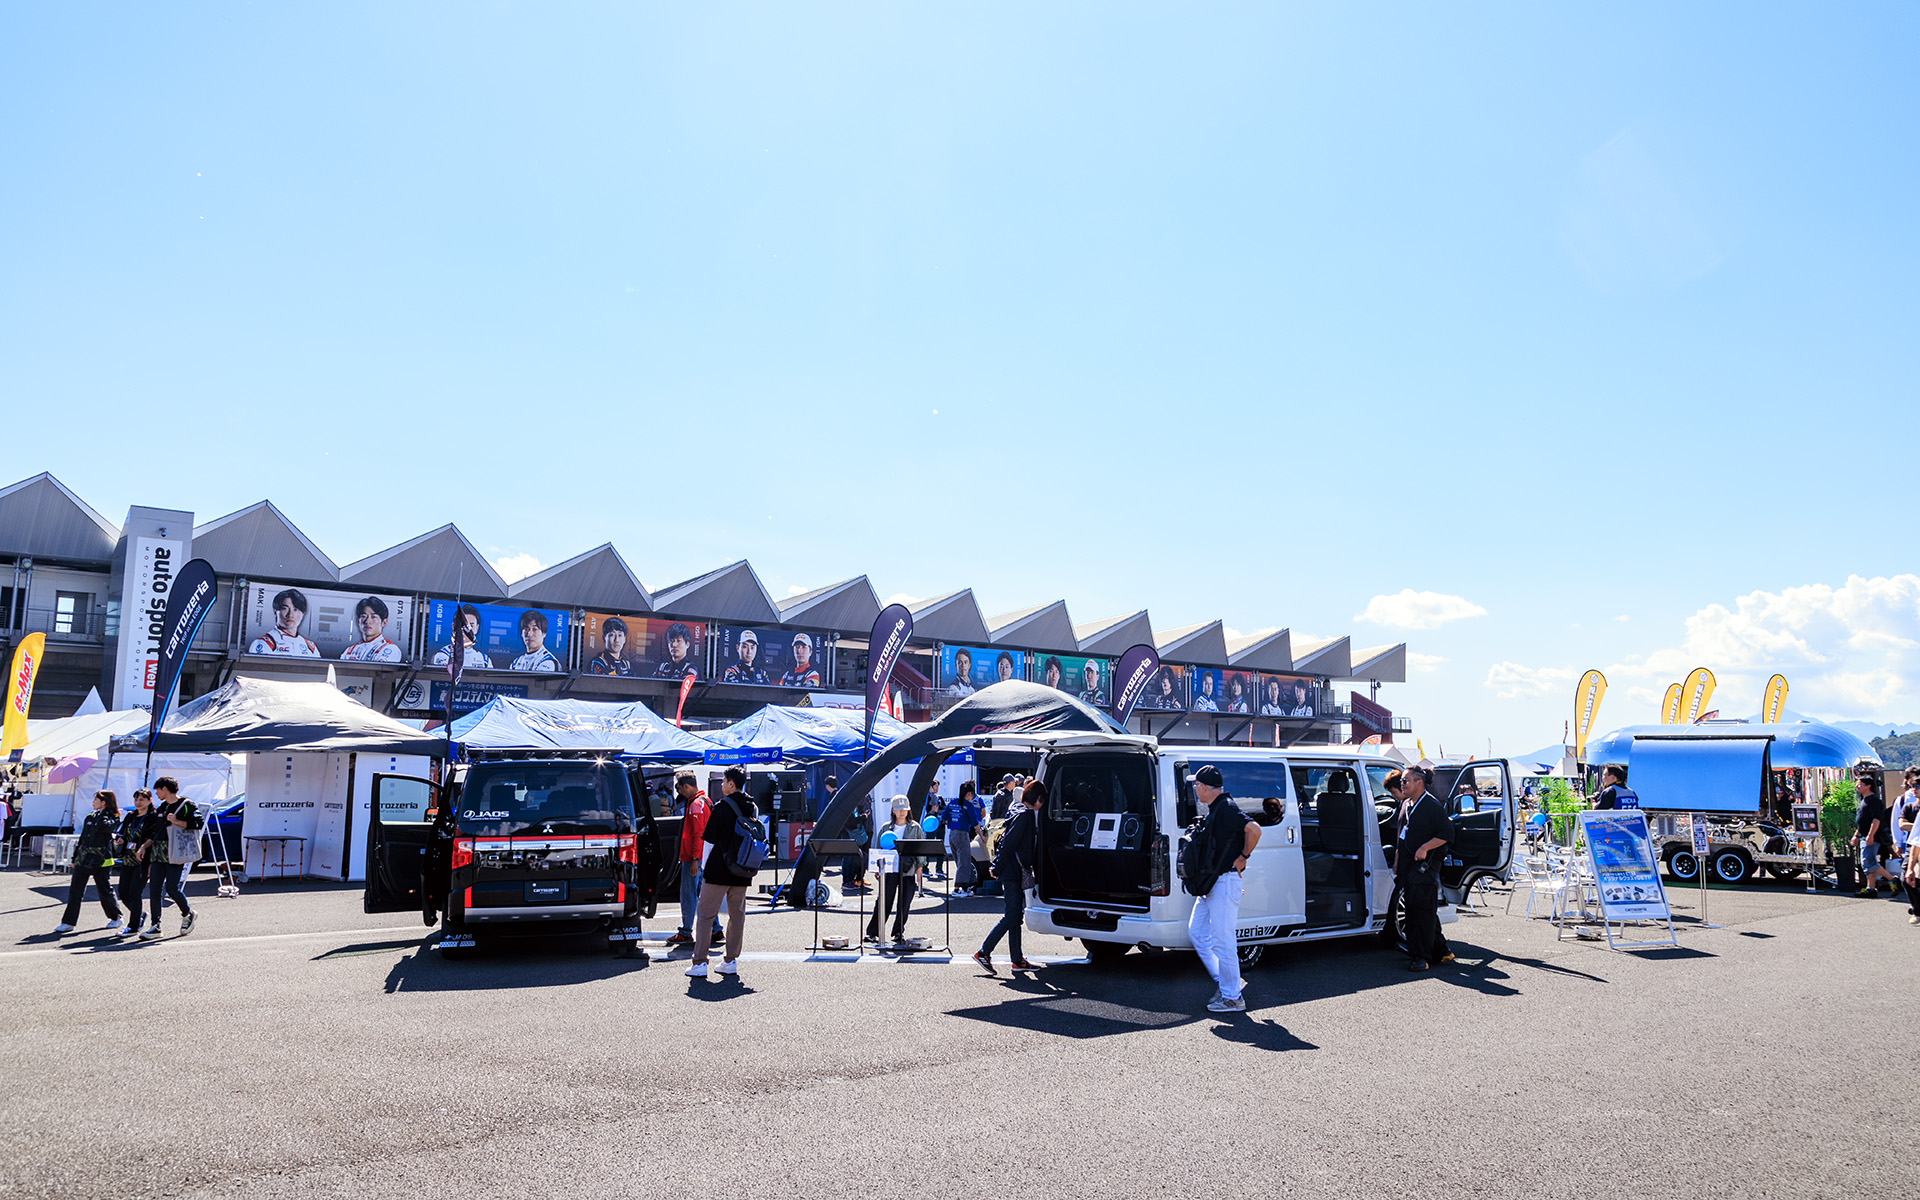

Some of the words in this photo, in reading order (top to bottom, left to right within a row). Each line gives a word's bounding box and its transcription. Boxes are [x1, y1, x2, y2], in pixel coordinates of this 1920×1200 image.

[138, 546, 150, 630] MOTORSPORT
[152, 547, 172, 594] auto
[145, 597, 167, 655] sport
[165, 579, 210, 660] carrozzeria
[180, 630, 189, 646] TRIP
[193, 604, 203, 620] EDGE
[132, 640, 142, 689] PORTAL
[872, 618, 906, 683] carrozzeria
[14, 652, 33, 713] B-Max
[146, 662, 158, 687] Web
[435, 682, 495, 691] モーターポーツを応援する
[1117, 657, 1152, 712] carrozzeria
[708, 753, 716, 761] 7
[258, 801, 315, 809] carrozzeria
[475, 810, 510, 818] JAOS
[1235, 924, 1264, 939] zzeria
